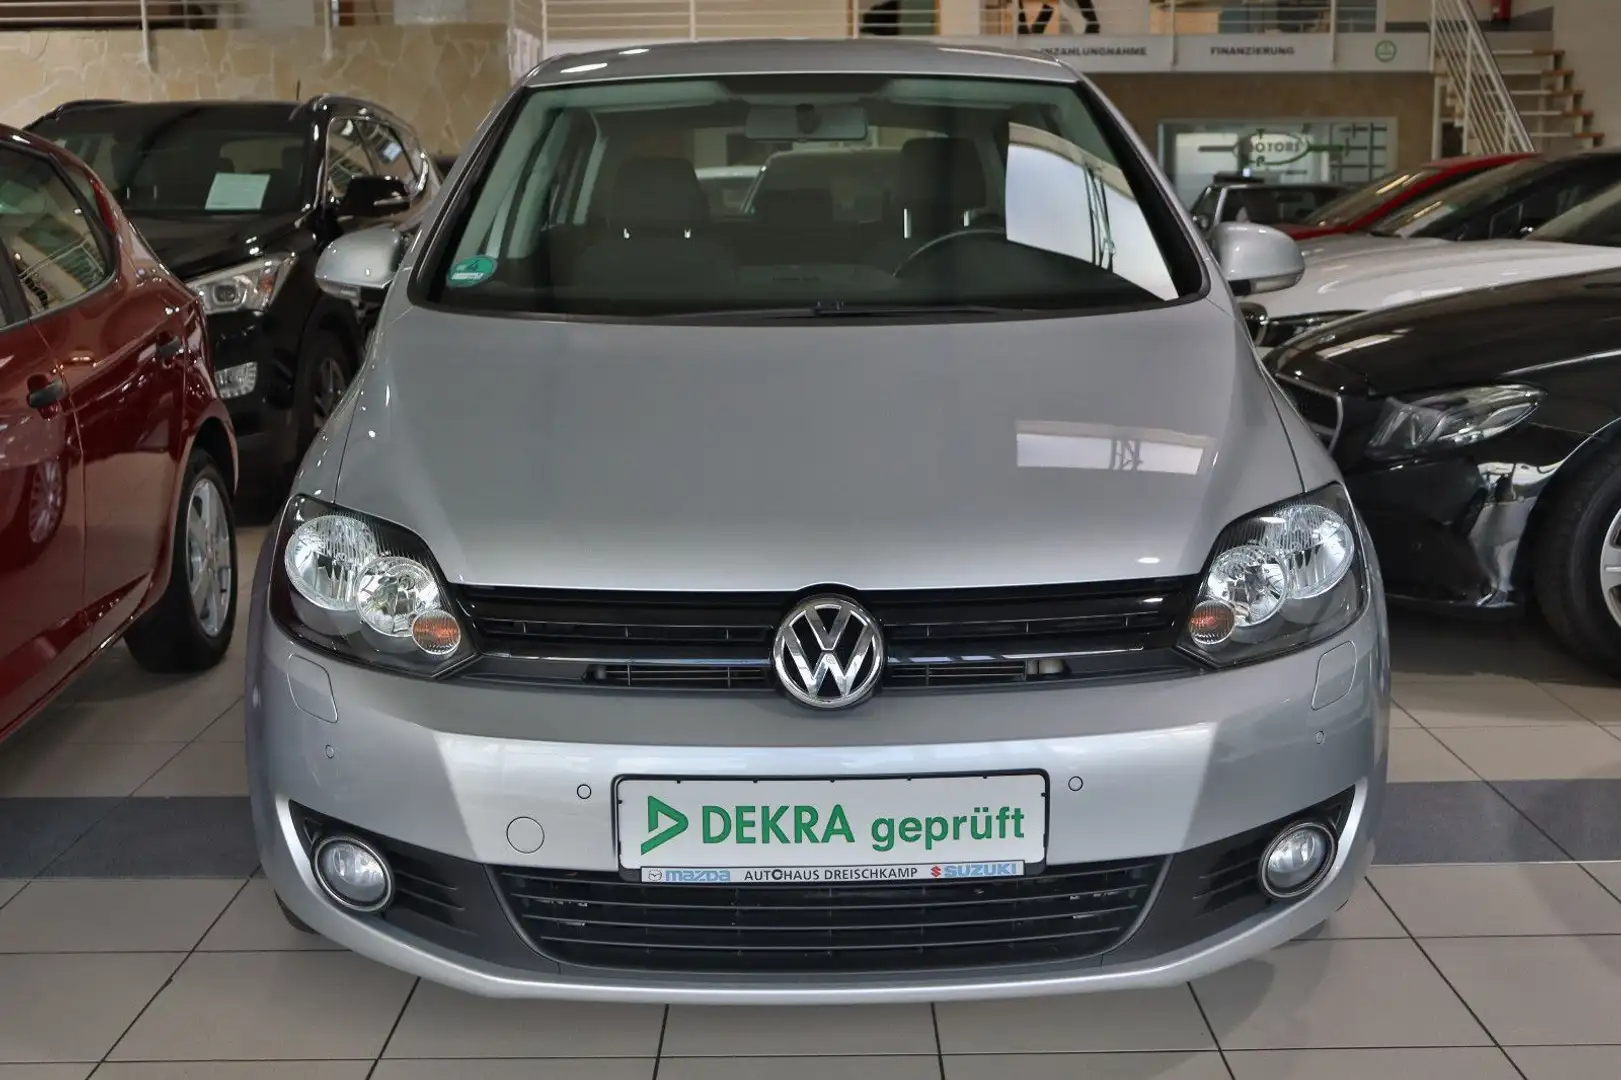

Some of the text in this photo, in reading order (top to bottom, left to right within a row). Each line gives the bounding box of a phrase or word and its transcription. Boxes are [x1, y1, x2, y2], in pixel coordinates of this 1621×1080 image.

[1210, 46, 1295, 56] FINANZIERUNG
[702, 804, 1024, 852] DEKRA geprüft
[744, 868, 820, 881] AUTOHAUS
[824, 867, 918, 880] DREISCHKAMP
[943, 863, 1017, 877] SUZUKI
